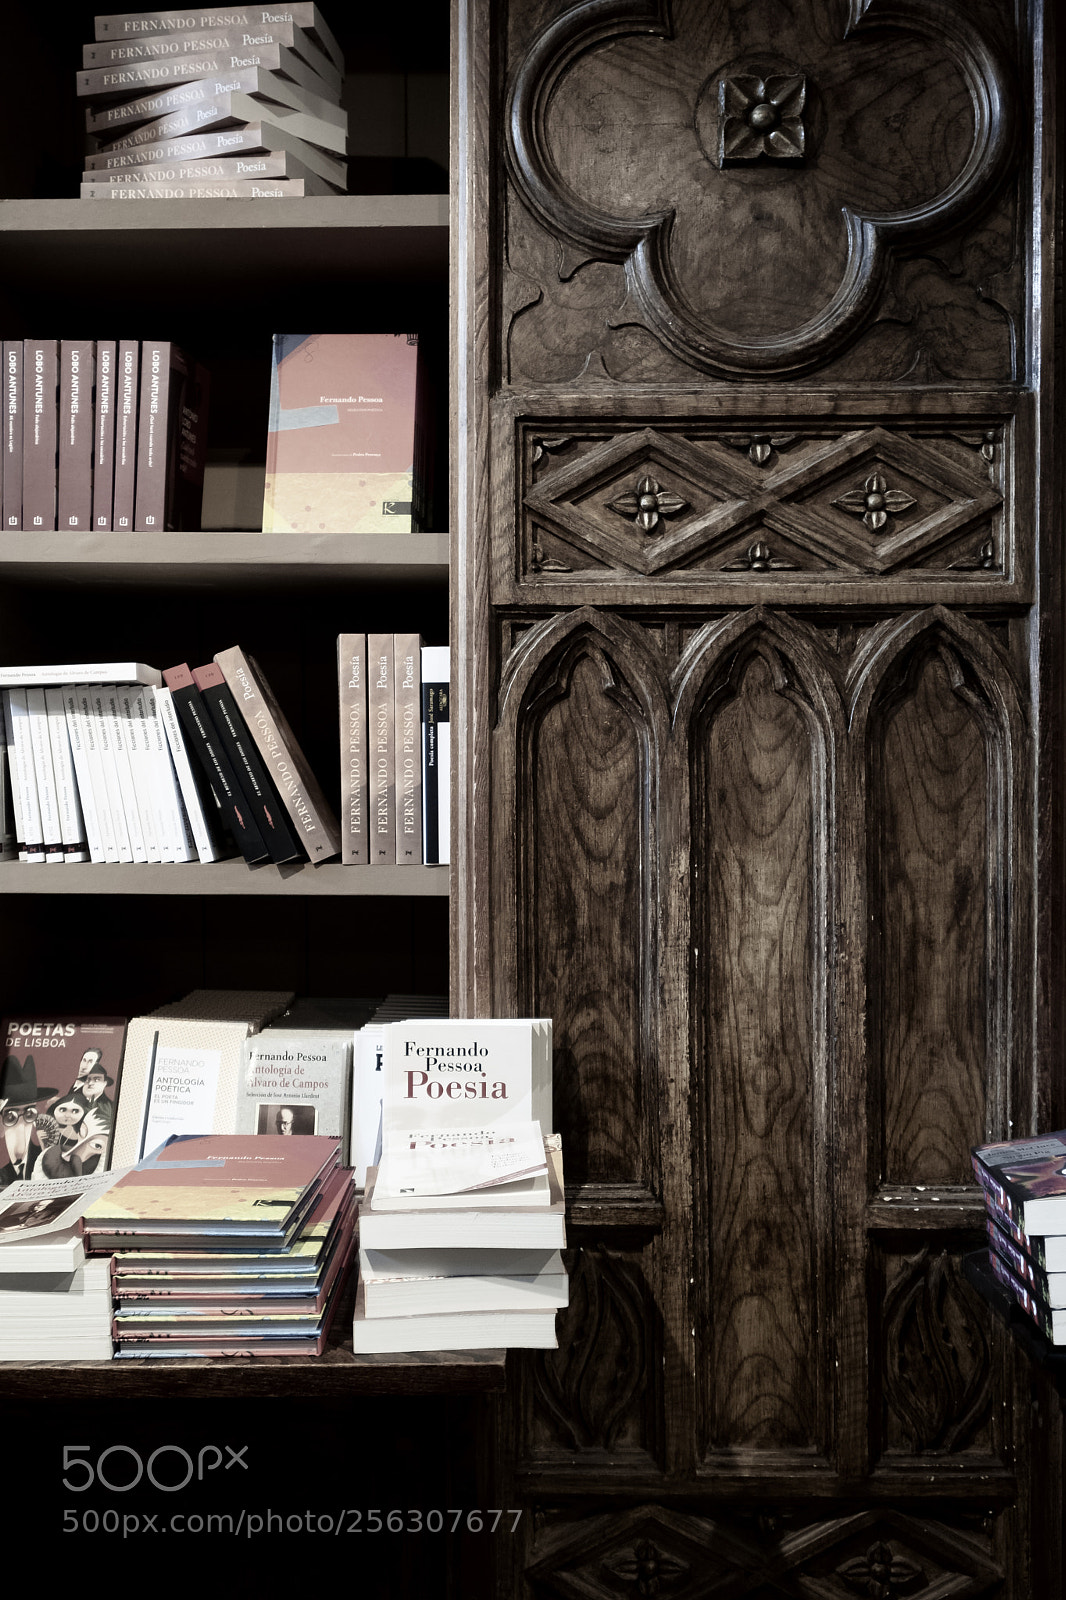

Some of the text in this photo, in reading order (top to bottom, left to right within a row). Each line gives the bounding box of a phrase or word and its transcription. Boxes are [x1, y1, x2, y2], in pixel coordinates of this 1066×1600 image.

[124, 17, 196, 32] FERNANDO
[200, 15, 249, 28] PESSOA
[111, 42, 179, 60] FERNANDO
[183, 38, 230, 52] PESSOA
[103, 66, 169, 85] FERNANDO
[173, 60, 219, 76] PESSOA
[107, 99, 163, 121] FERNANDO
[166, 88, 205, 107] PESSOA
[112, 128, 156, 153] FERNANDO
[158, 115, 190, 136] PESSOA
[106, 148, 164, 169] FERNANDO
[167, 139, 206, 157] PESSOA
[109, 169, 175, 184] FERNANDO
[180, 165, 225, 179] PESSOA
[111, 188, 184, 199] FERNANDO
[189, 187, 238, 198] PESSOA
[8, 351, 17, 374] LOBO
[35, 350, 43, 374] LOBO
[71, 350, 79, 374] LOBO
[101, 350, 110, 374] LOBO
[124, 351, 132, 374] LOBO
[152, 350, 160, 374] LOBO
[8, 374, 17, 414] ANTUNES
[35, 374, 43, 414] ANTUNES
[71, 374, 79, 414] ANTUNES
[101, 374, 109, 414] ANTUNES
[123, 374, 132, 414] ANTUNES
[150, 374, 159, 414] ANTUNES
[236, 667, 315, 833] FERNANDO PESSOA Poesía
[348, 655, 361, 834] FERNANDO PESSOA Poesía
[376, 655, 388, 834] FERNANDO PESSOA Poesía
[402, 655, 415, 834] FERNANDO PESSOA Poesía
[8, 1022, 76, 1037] POETAS
[5, 1038, 66, 1048] DE LISBOA
[404, 1041, 489, 1057] Fernando
[159, 1058, 205, 1068] FERNANDO
[249, 1050, 327, 1062] rnando Pessoa
[425, 1057, 483, 1072] Pessoa
[157, 1065, 190, 1074] PESSOA
[252, 1064, 305, 1077] ntología de
[280, 1078, 290, 1088] de
[292, 1078, 329, 1091] Campos
[403, 1070, 509, 1099] Poesia
